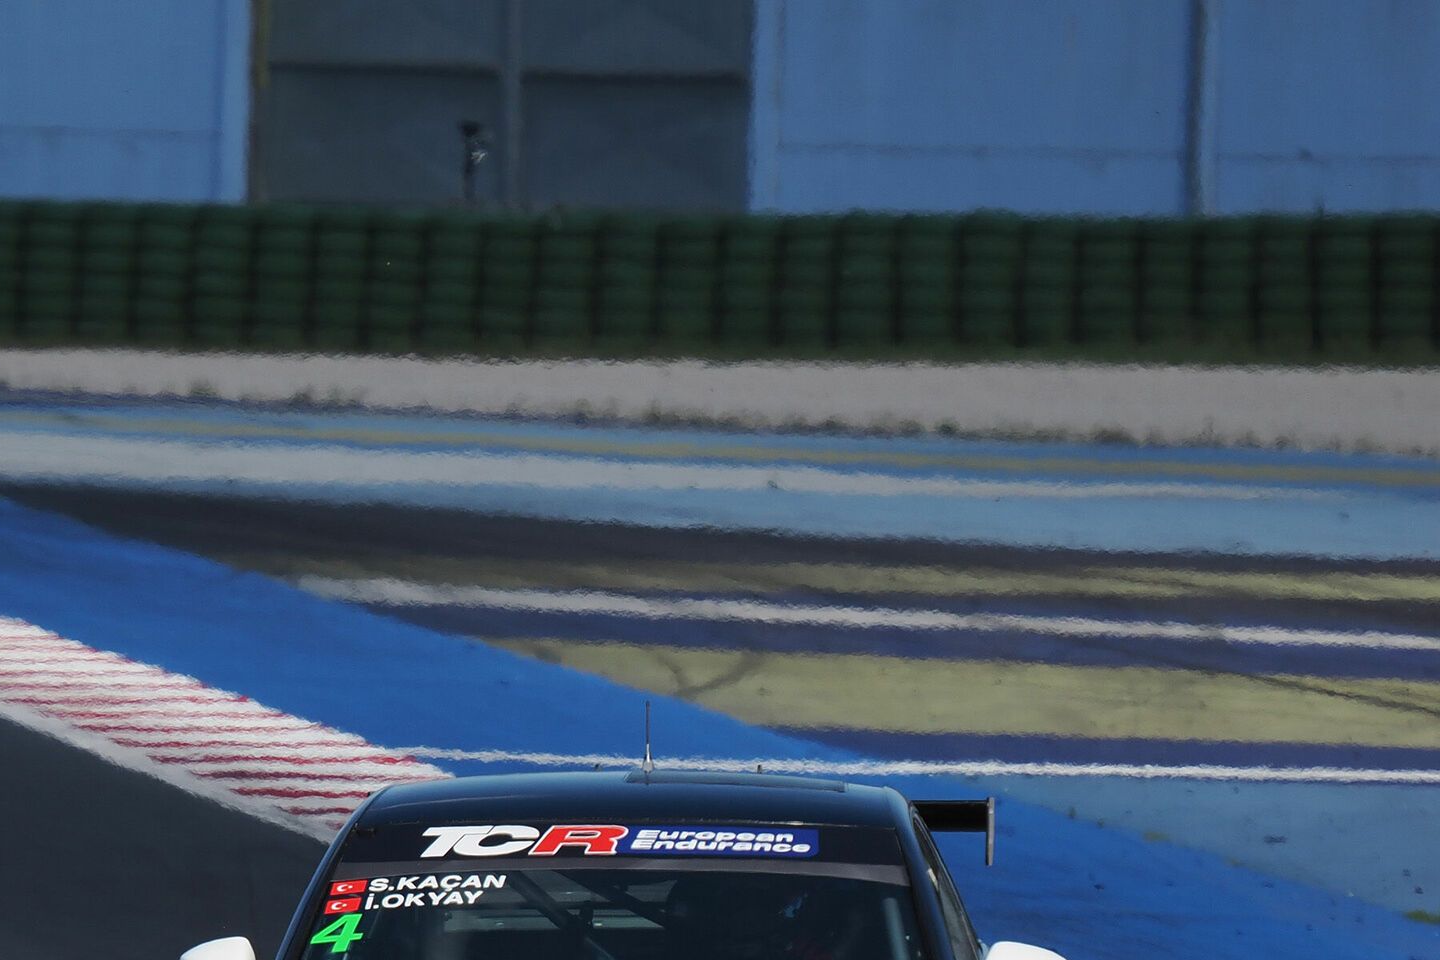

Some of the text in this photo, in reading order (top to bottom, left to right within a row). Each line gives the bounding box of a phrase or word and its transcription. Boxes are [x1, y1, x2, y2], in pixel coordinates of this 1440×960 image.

[420, 824, 794, 859] TCR European
[630, 839, 811, 854] Endurance
[368, 874, 507, 892] S.KAÇAN
[310, 913, 364, 953] 4
